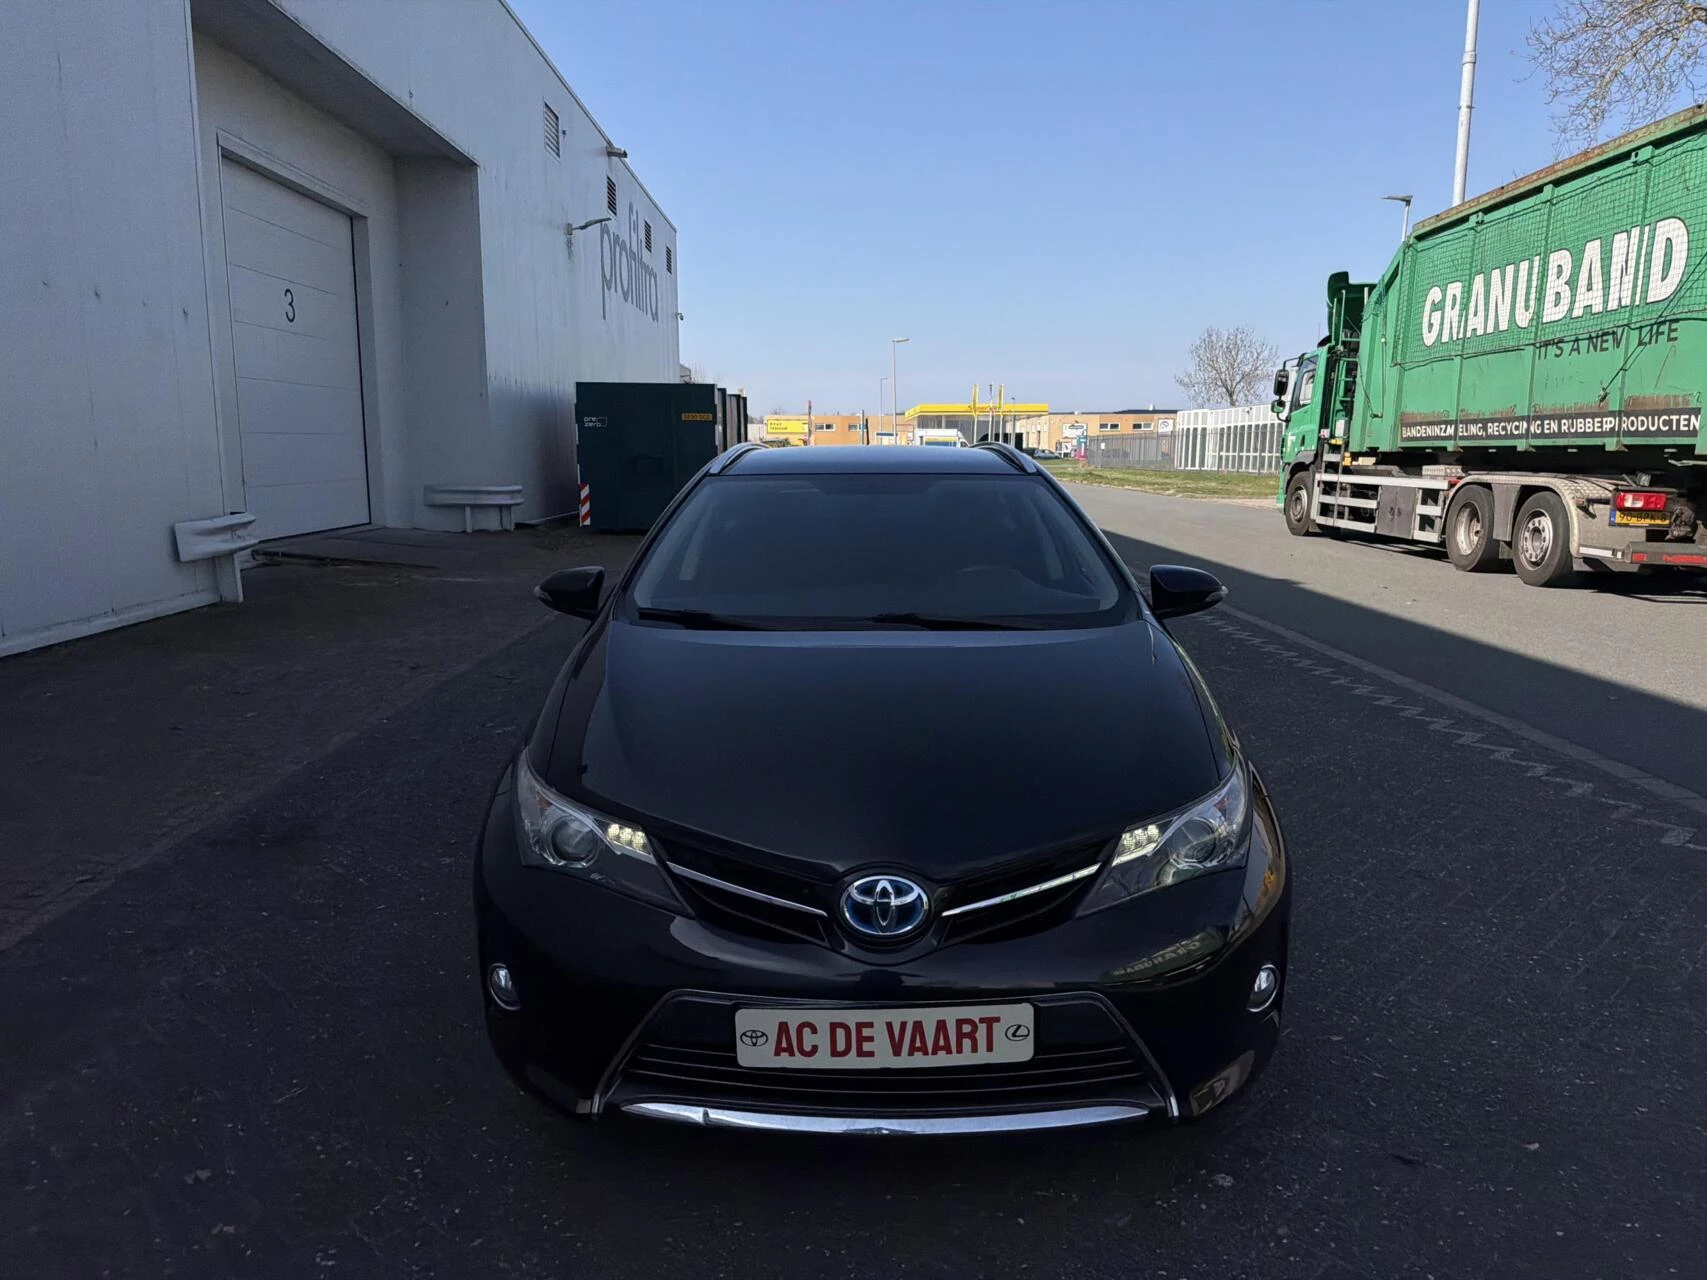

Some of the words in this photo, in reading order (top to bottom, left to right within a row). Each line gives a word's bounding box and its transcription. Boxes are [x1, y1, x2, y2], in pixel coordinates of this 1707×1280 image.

[1421, 216, 1690, 348] GRANUBAND
[284, 288, 296, 323] 3
[1568, 336, 1581, 357] A
[1636, 319, 1681, 347] LIFE
[1543, 419, 1558, 434] EN
[773, 1020, 819, 1058] AC
[829, 1021, 875, 1058] DE
[885, 1016, 1001, 1058] VAART
